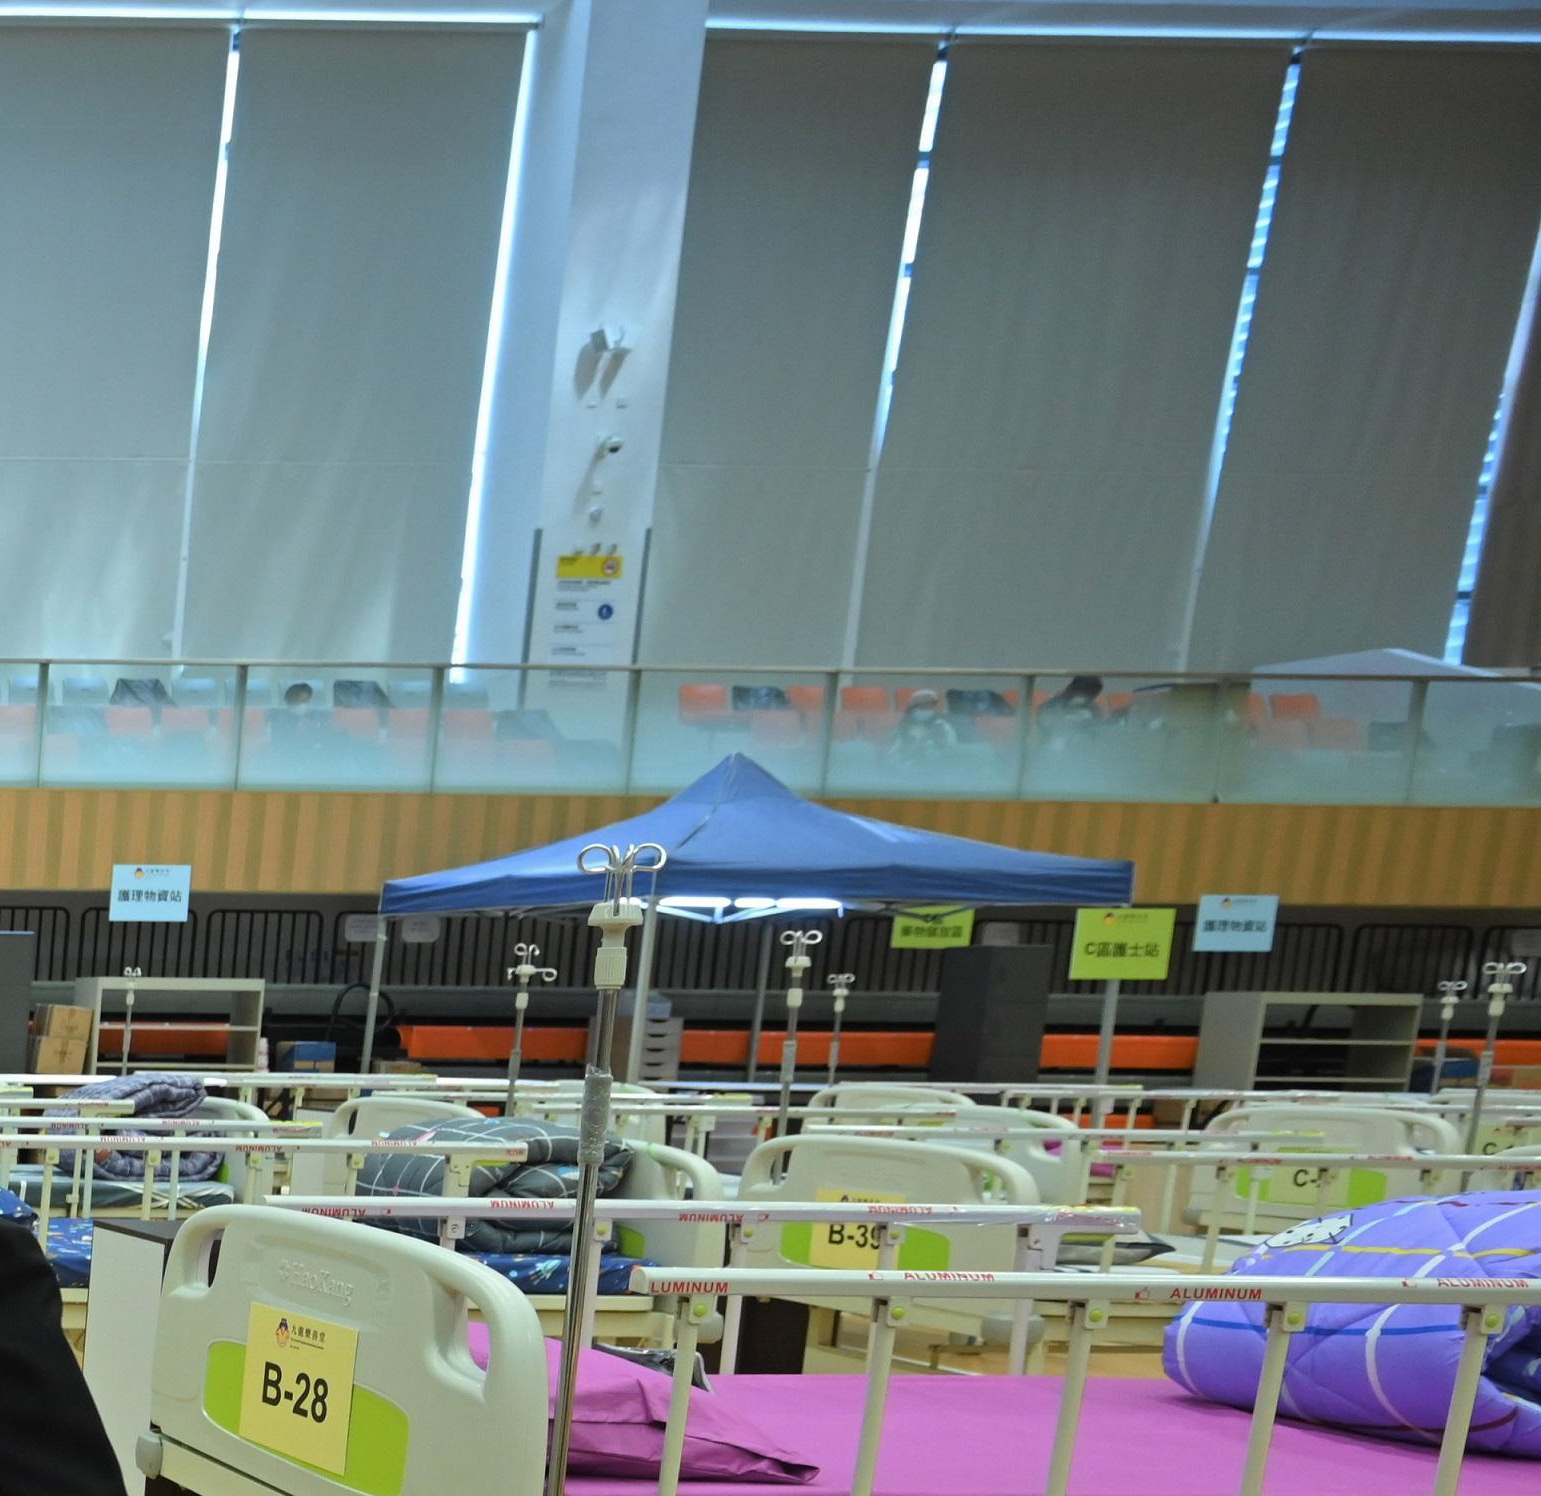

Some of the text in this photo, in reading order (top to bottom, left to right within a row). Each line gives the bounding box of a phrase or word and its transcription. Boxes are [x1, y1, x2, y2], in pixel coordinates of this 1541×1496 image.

[490, 1199, 555, 1209] ALUMINUM
[679, 1212, 744, 1222] ALUMINUM
[903, 1271, 996, 1282] ALUMINUM
[1437, 1277, 1529, 1289] ALUMINUM
[1170, 1287, 1263, 1301] ALUMINUM
[262, 1361, 329, 1423] B-28
